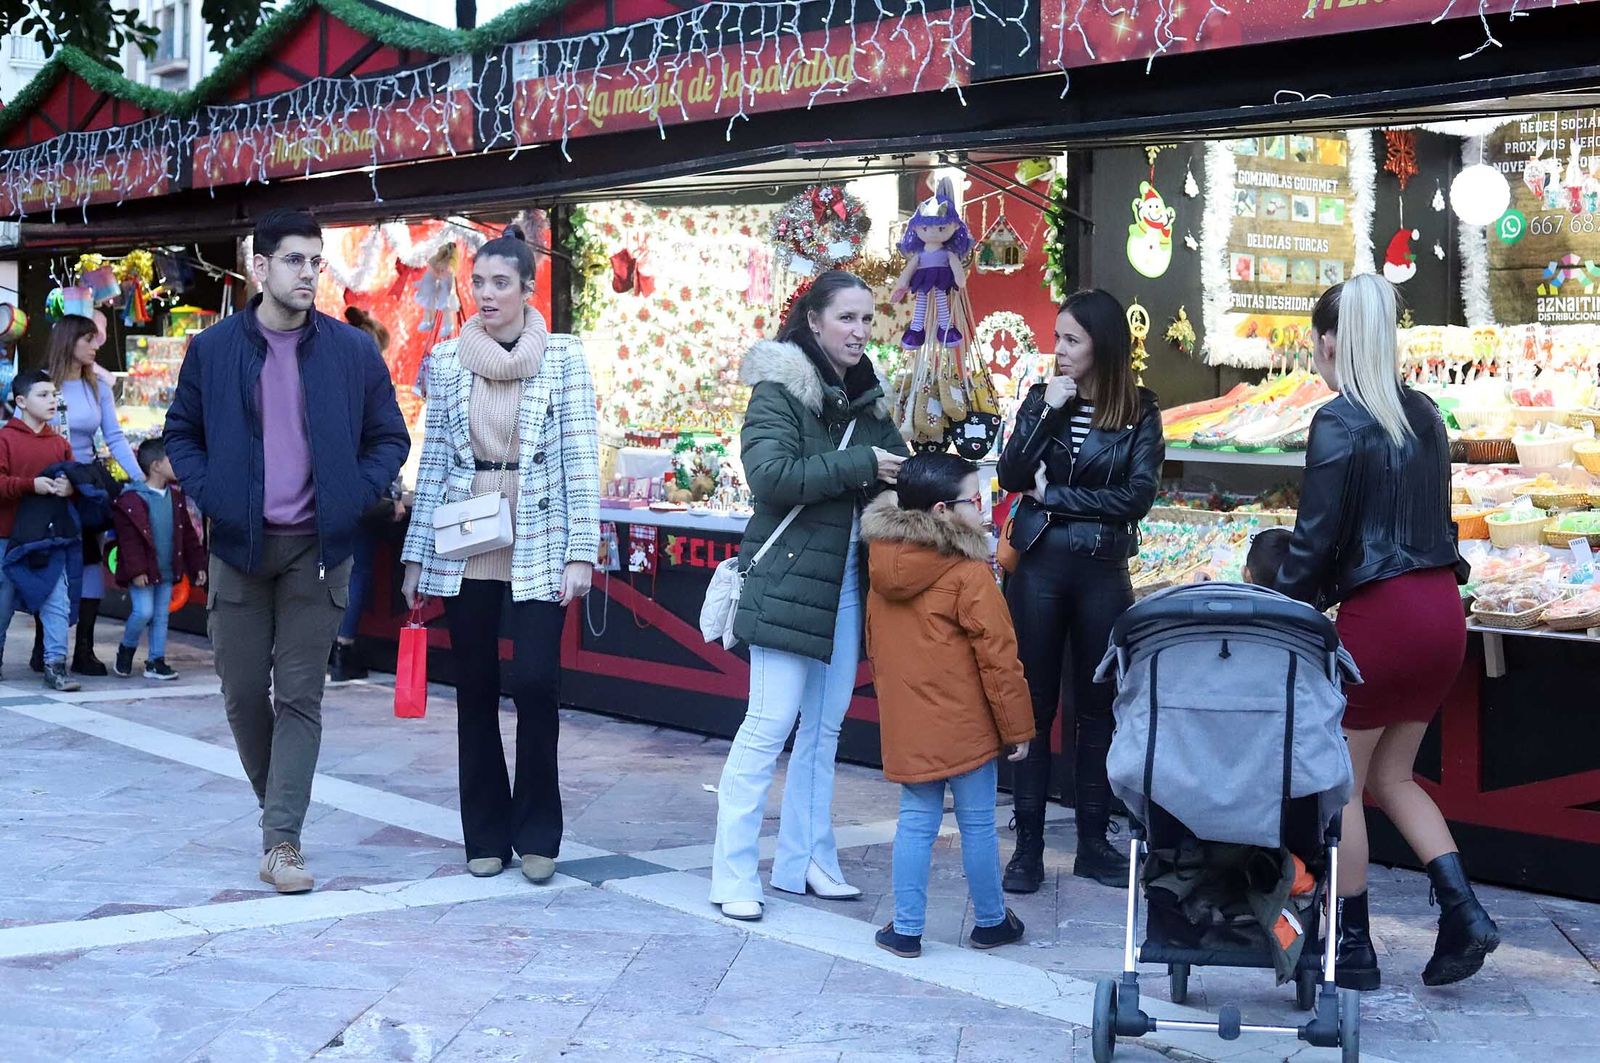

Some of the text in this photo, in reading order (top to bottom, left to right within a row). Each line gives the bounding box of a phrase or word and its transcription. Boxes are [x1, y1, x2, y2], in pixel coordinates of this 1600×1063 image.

[612, 72, 684, 121] magia
[687, 66, 714, 105] de
[720, 63, 743, 100] la
[750, 46, 854, 95] navidad
[1520, 120, 1556, 133] REDES
[1237, 170, 1338, 193] GOMINOLAS GOURMET
[1530, 215, 1563, 235] 667
[1247, 233, 1328, 252] DELICIAS TURCAS
[1231, 293, 1264, 309] FRUTAS
[674, 536, 741, 569] FELI
